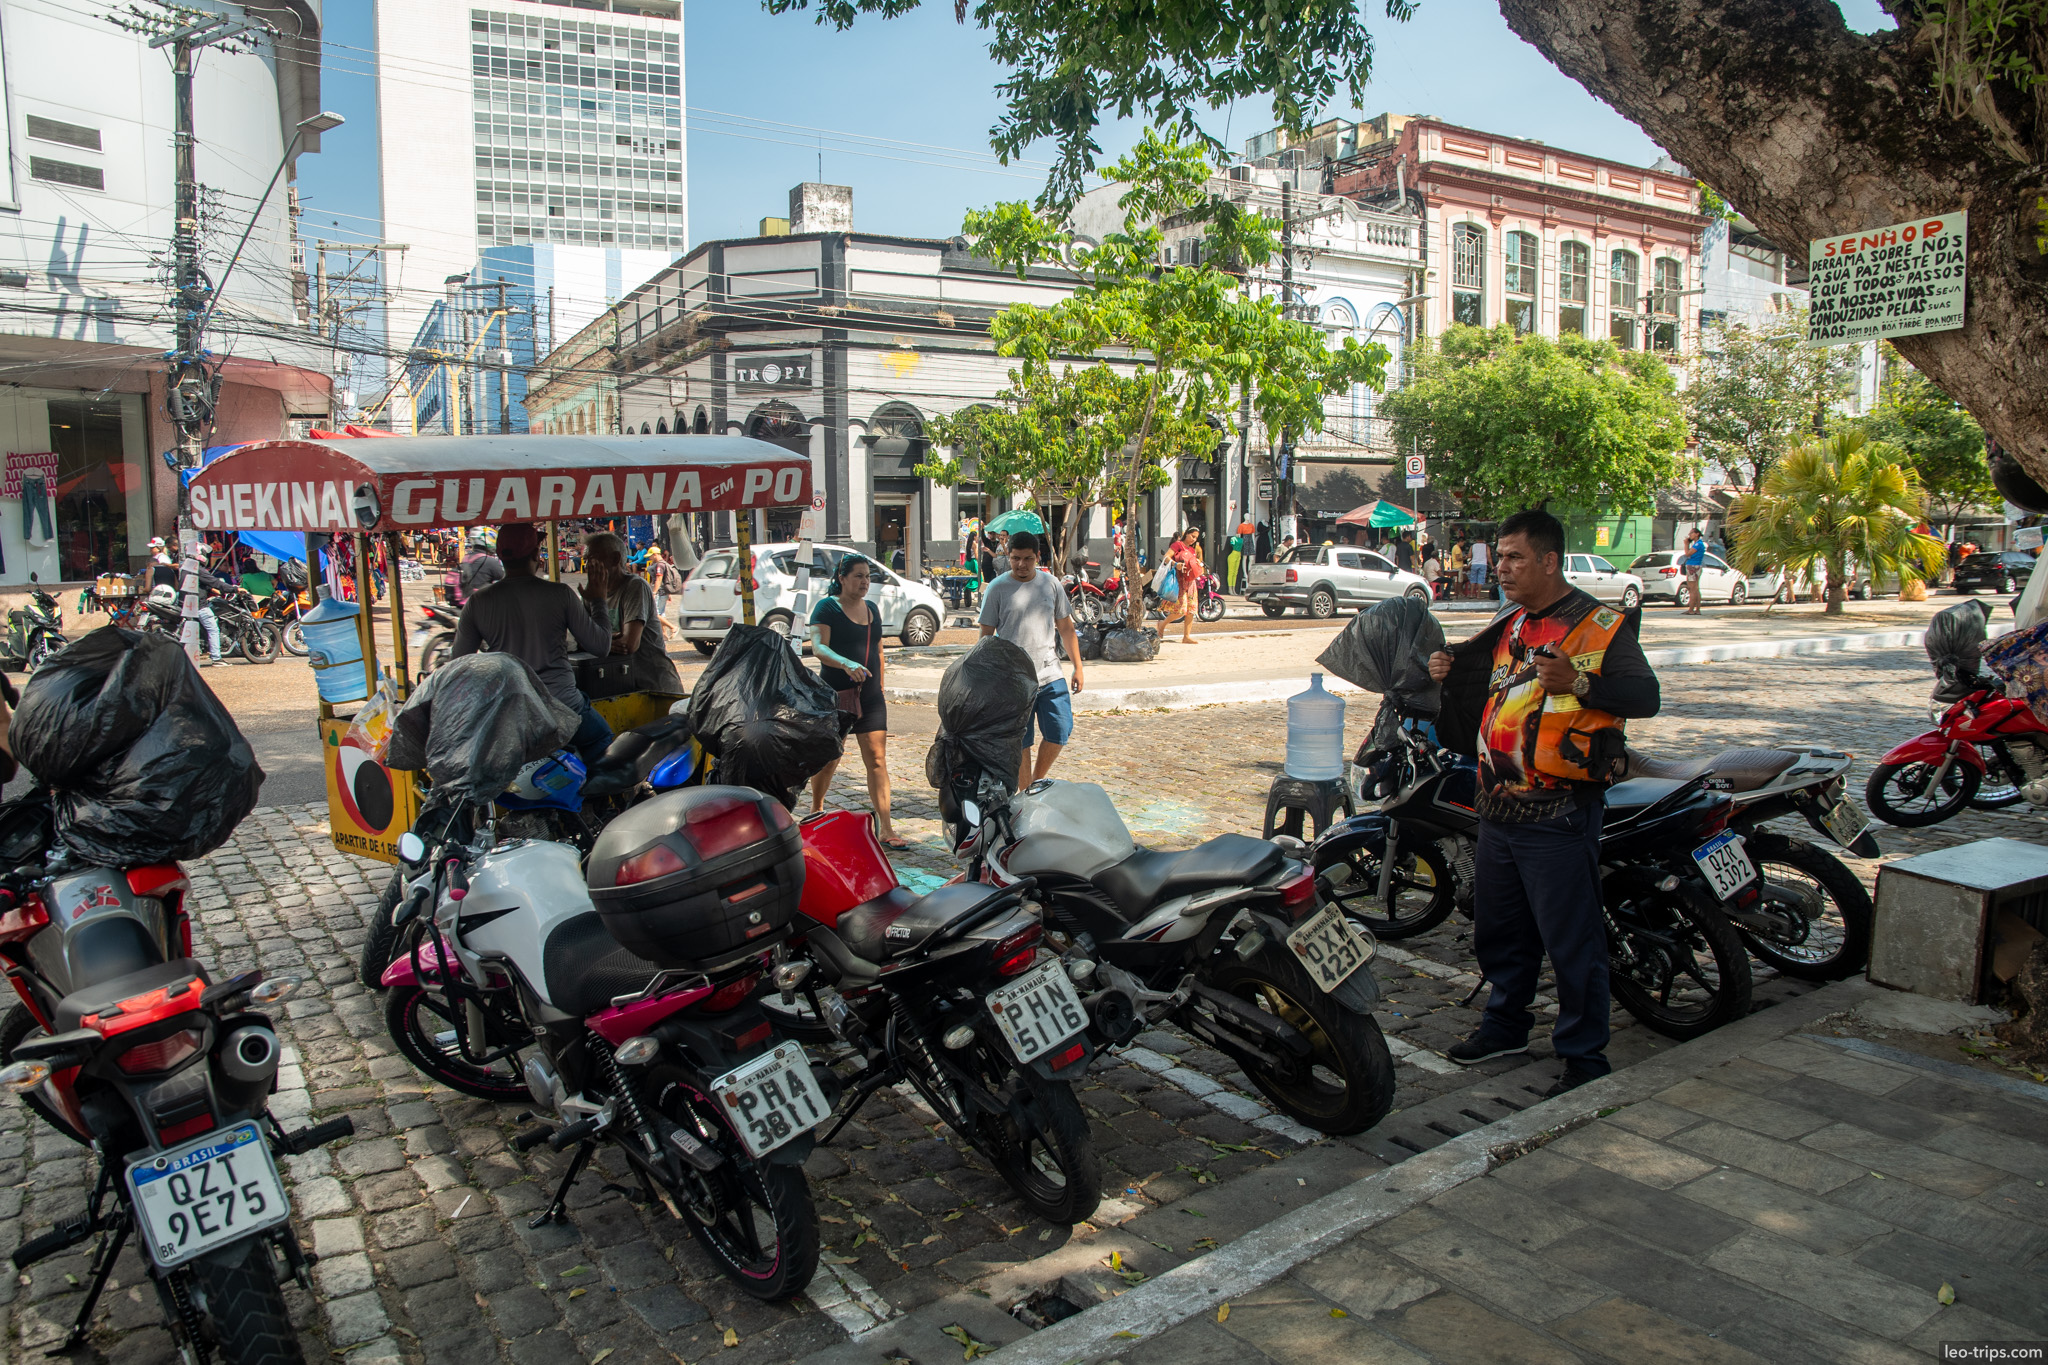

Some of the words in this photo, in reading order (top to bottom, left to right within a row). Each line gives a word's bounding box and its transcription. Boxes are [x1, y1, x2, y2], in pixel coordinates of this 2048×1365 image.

[1812, 253, 1865, 272] DERRAMA
[1870, 243, 1912, 262] SOBRE
[1922, 232, 1962, 253] NÓS
[1825, 221, 1944, 256] SENHOR
[1811, 274, 1821, 285] A
[1823, 268, 1850, 283] SUA
[1856, 264, 1881, 278] PAZ
[1885, 255, 1929, 273] NESTE
[1935, 250, 1964, 266] DIA
[1811, 286, 1818, 298] E
[1821, 282, 1847, 296] QUE
[1853, 275, 1896, 292] TODOS
[1907, 265, 1965, 284] PASSOS
[1809, 305, 1884, 326] CONDUZIDOS
[1887, 299, 1927, 316] PELAS
[1928, 301, 1951, 310] SUAS
[1811, 299, 1835, 314] DAS
[1840, 290, 1895, 309] NOSSAS
[1897, 285, 1935, 300] VIDAS
[1936, 286, 1961, 296] SEJA
[1847, 327, 1862, 336] BOM
[1864, 325, 1879, 335] DIA
[1882, 320, 1897, 331] BOA
[1899, 318, 1921, 329] TARDE
[1925, 318, 1940, 326] BOA
[1941, 313, 1963, 324] NOITE
[1412, 461, 1418, 470] E
[390, 471, 702, 524] GUARANA
[711, 477, 734, 499] EM
[741, 467, 802, 505] PO
[335, 832, 368, 850] APARTIR
[369, 838, 379, 853] DE
[381, 842, 386, 854] 1
[1707, 840, 1723, 853] BRASIL
[1708, 845, 1738, 872] QZR
[1715, 860, 1750, 892] 3J92
[891, 927, 911, 939] FACTOR
[1321, 938, 1361, 981] 4237
[1007, 974, 1046, 1001] AM-MANAUS
[1004, 980, 1067, 1031] PHN
[1018, 1003, 1082, 1056] 5116
[738, 1069, 807, 1122] PHA
[749, 1094, 819, 1149] 3811
[173, 1146, 221, 1170] BRASIL
[168, 1152, 237, 1205] QZT
[168, 1180, 266, 1247] 9E75
[160, 1242, 177, 1258] BR
